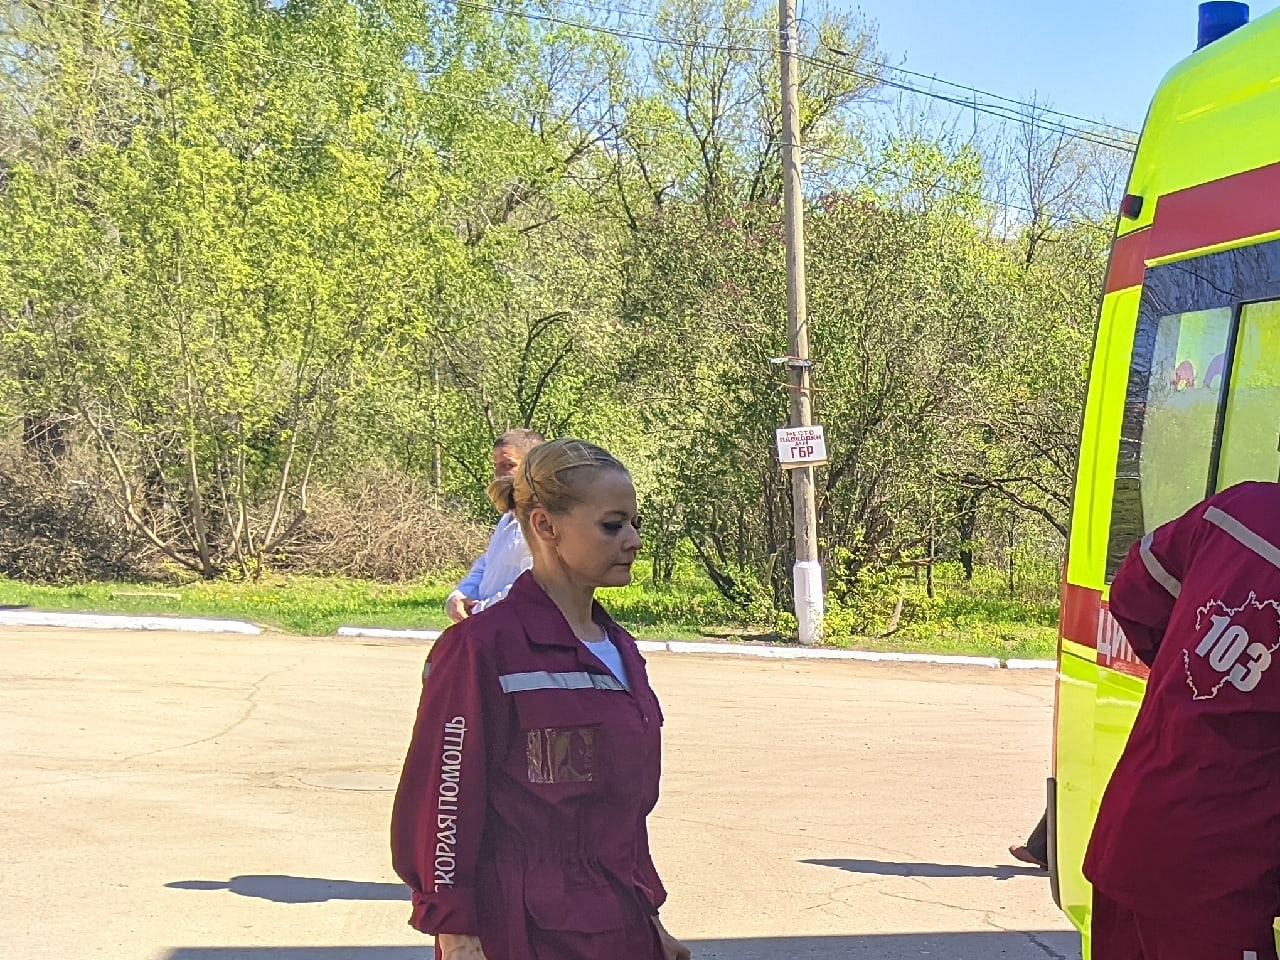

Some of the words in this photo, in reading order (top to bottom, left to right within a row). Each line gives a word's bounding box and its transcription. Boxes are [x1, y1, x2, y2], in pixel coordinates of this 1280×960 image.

[790, 446, 814, 459] ГБР
[1195, 614, 1272, 692] 103
[437, 716, 468, 811] ПОМОЩЬ
[434, 814, 458, 893] КОРАЯ
